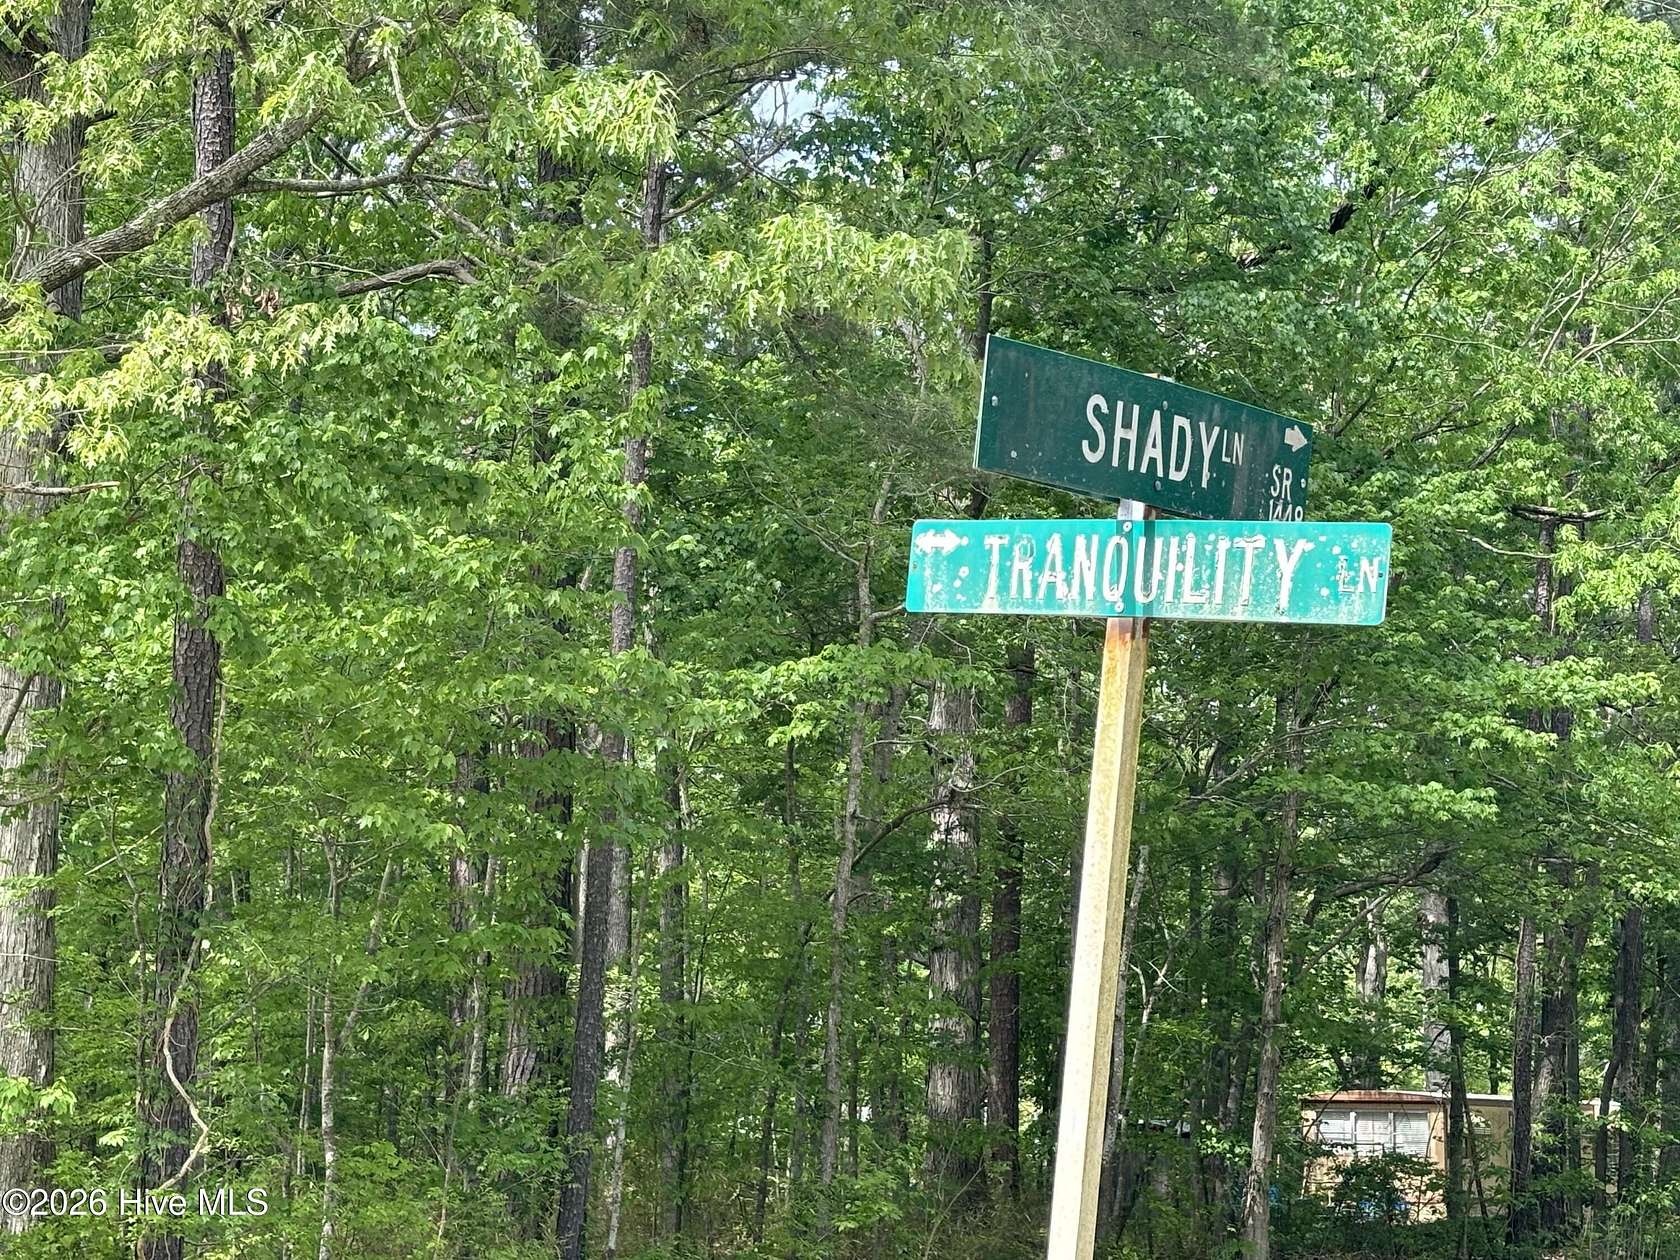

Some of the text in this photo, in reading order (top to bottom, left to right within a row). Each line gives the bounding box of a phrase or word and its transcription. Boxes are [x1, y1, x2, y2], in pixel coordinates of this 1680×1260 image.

[1082, 394, 1245, 488] SHADY LN
[1270, 464, 1293, 500] SR
[984, 533, 1379, 610] TRANQUILITY LN
